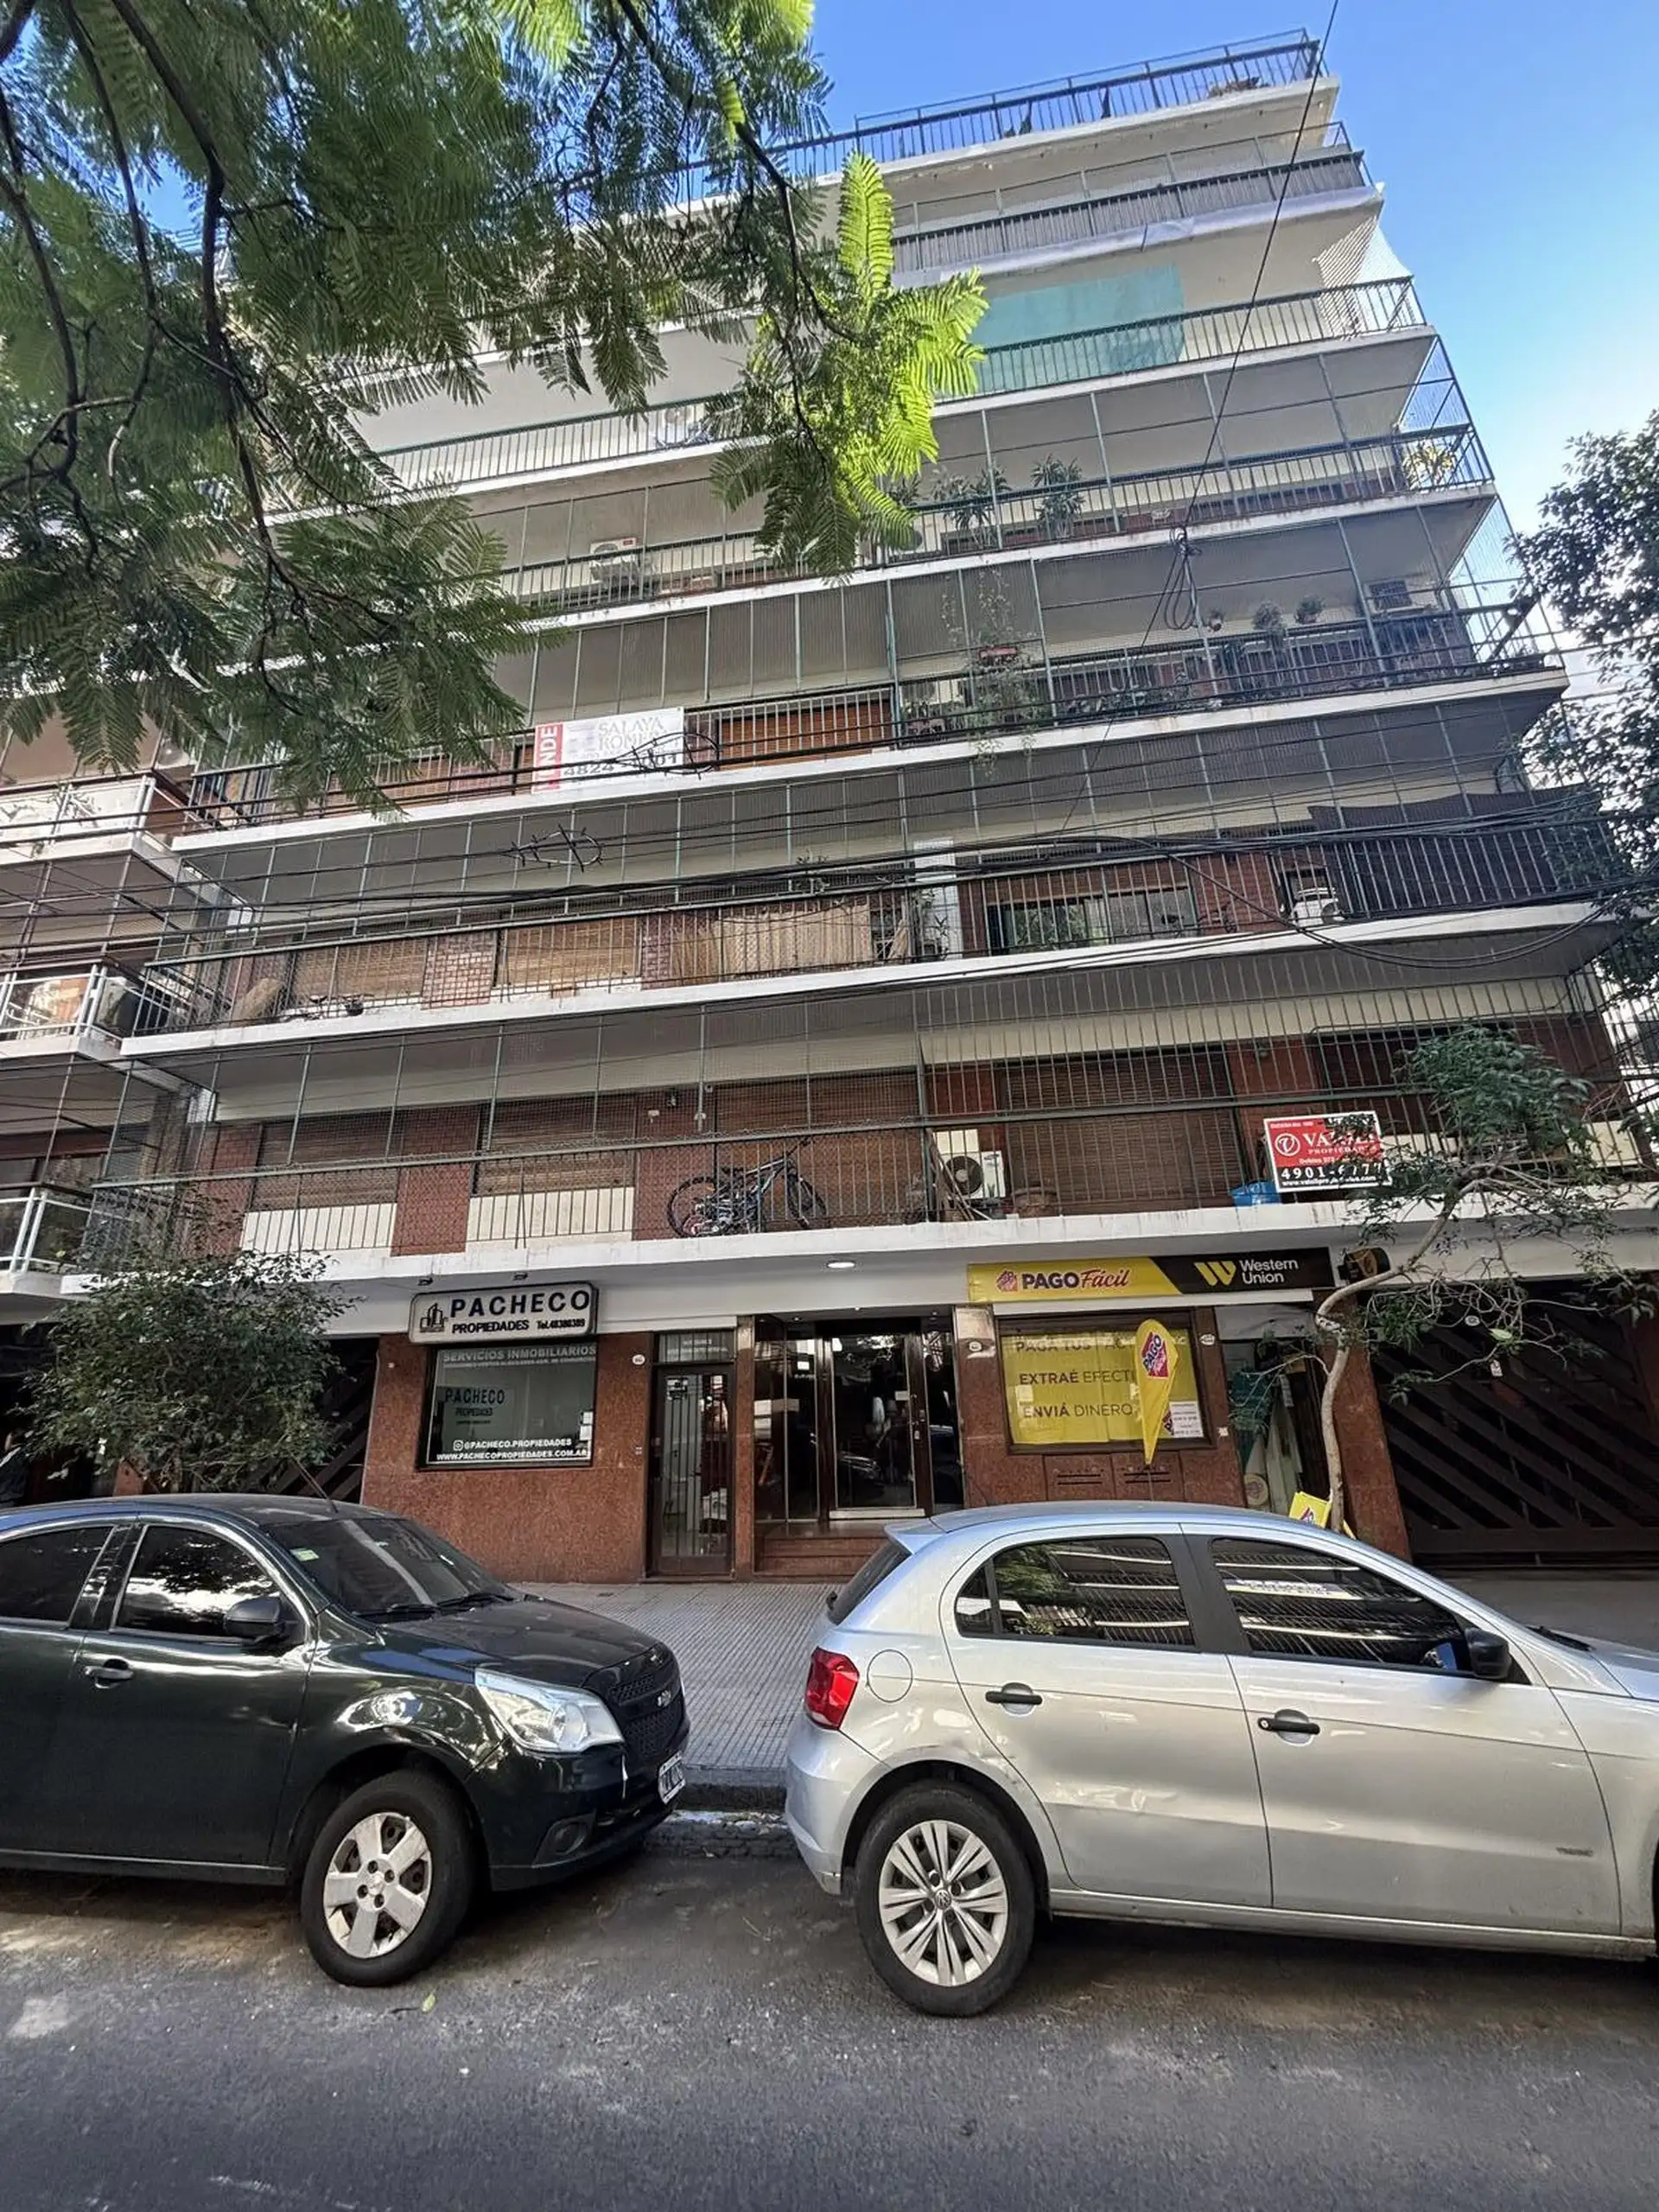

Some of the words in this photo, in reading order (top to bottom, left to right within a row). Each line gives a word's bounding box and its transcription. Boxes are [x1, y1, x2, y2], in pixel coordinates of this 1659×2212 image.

[1239, 1258, 1299, 1272] Western
[1021, 1271, 1079, 1289] PAGO
[1079, 1268, 1131, 1290] Fácil
[1242, 1272, 1285, 1285] Union
[450, 1290, 590, 1319] PACHECO
[451, 1319, 530, 1334] PROPIEDADES
[442, 1349, 505, 1363] SERVICIOS
[505, 1345, 597, 1360] INMOBILIARIOS
[1142, 1334, 1162, 1372] PAGO
[1019, 1369, 1080, 1385] EXTRAÉ
[1083, 1369, 1136, 1383] EFECTI
[445, 1388, 505, 1404] PACHECO
[1023, 1402, 1071, 1418] ENVIÁ
[463, 1438, 572, 1450] @PACHECO.PROPIEDADES
